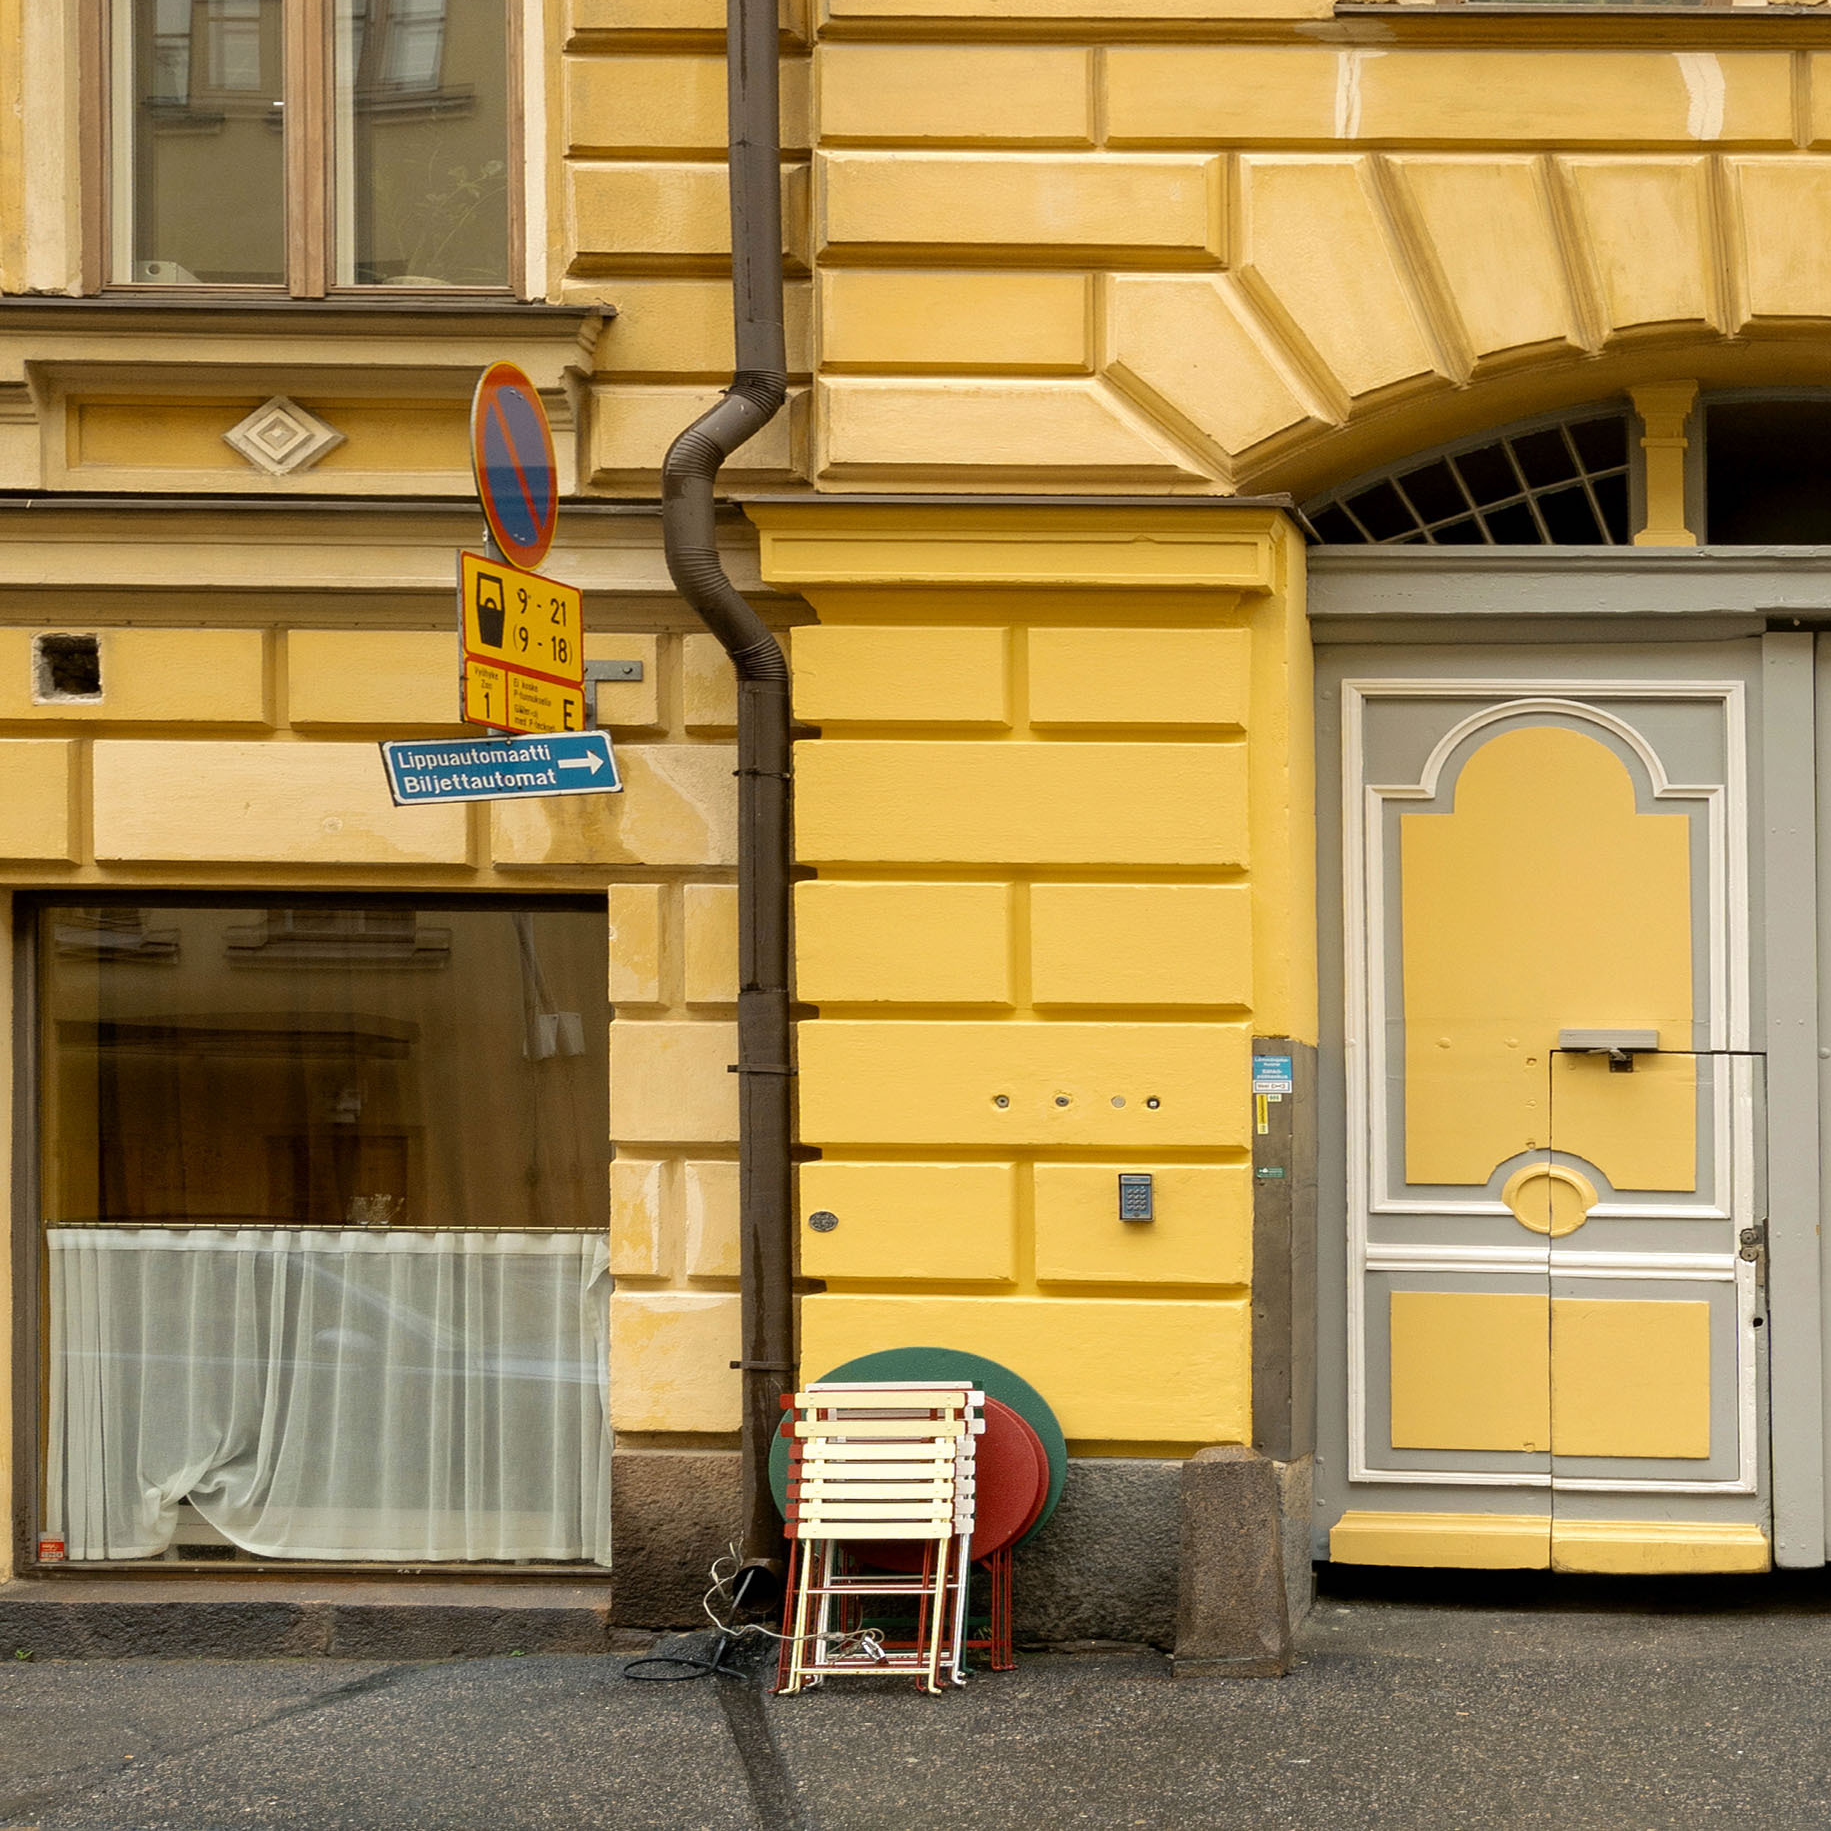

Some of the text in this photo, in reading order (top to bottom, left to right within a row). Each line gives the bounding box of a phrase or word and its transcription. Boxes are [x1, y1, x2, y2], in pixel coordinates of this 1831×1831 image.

[517, 587, 528, 614] 9
[550, 598, 567, 627] 21
[513, 625, 529, 653] (9
[551, 635, 573, 666] 18)
[484, 692, 490, 719] 1
[563, 699, 575, 731] E
[397, 744, 551, 770] Lippuautomaatti
[403, 768, 557, 794] Biljettautomat
